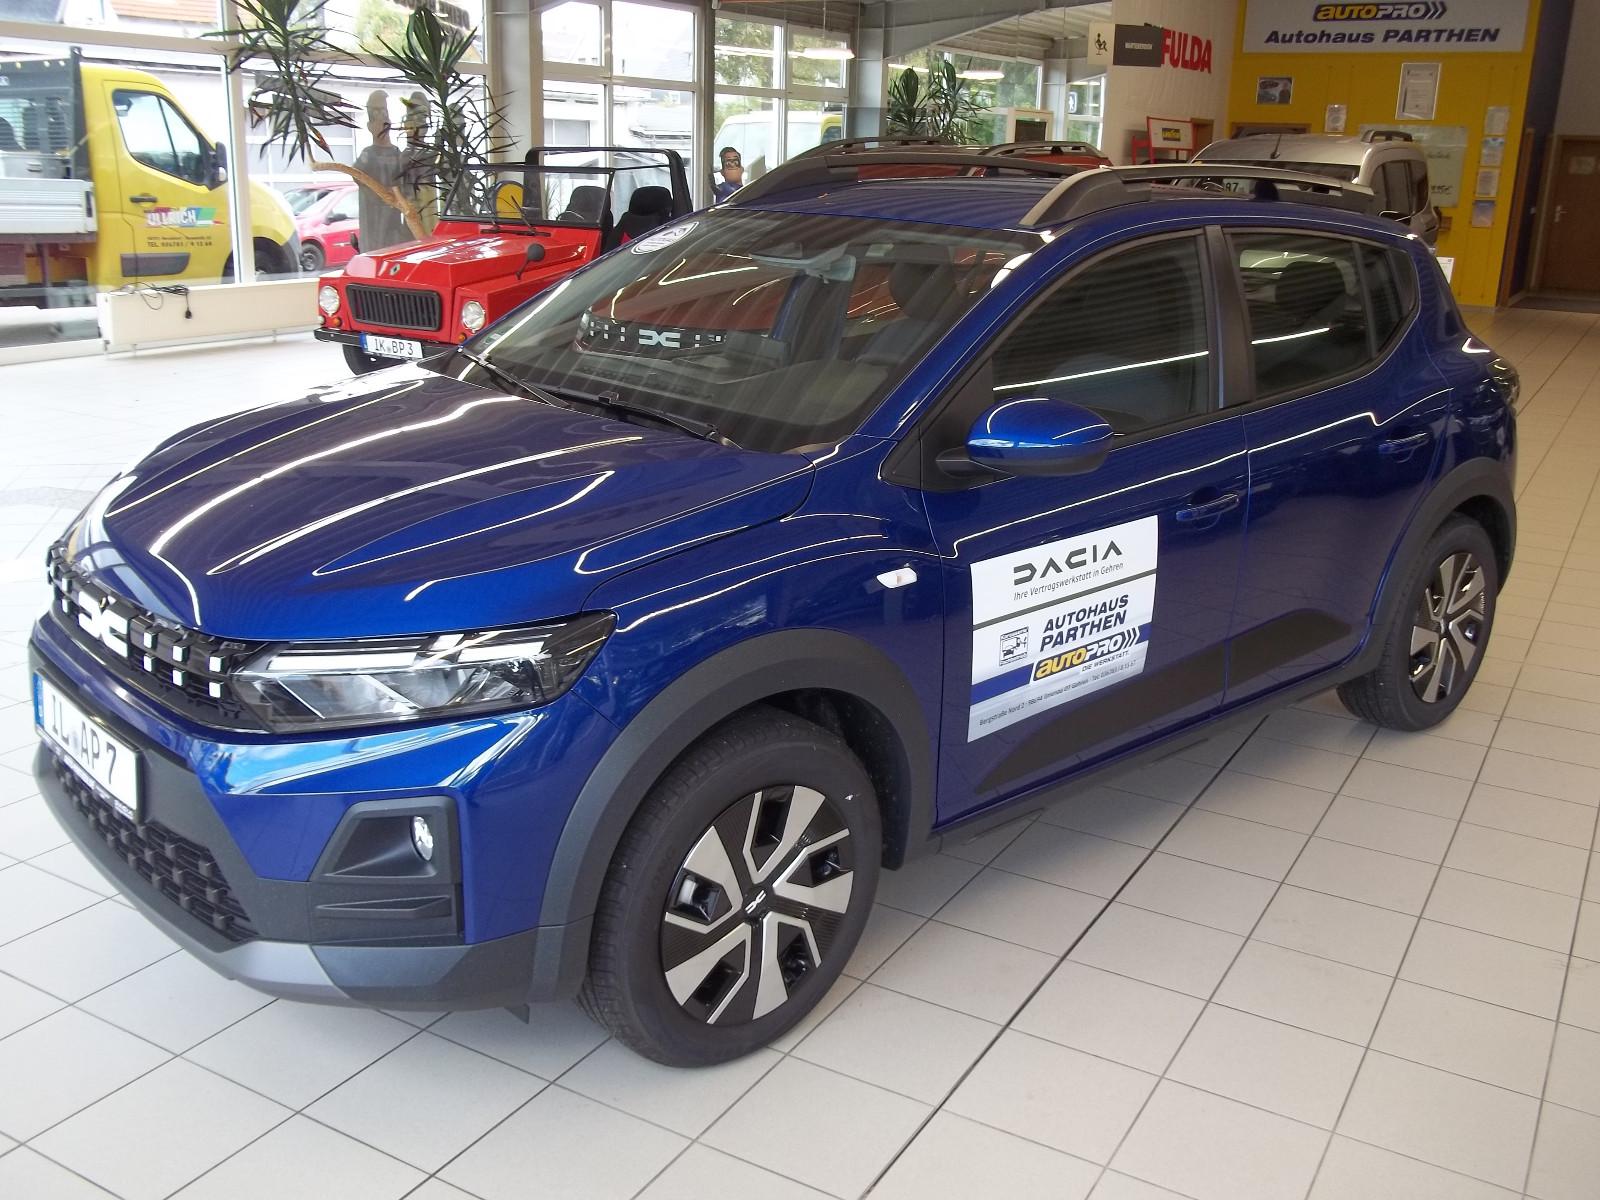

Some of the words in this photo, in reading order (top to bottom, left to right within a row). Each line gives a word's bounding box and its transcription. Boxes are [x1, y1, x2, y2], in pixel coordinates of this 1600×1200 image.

[1161, 27, 1212, 74] FULDA
[1264, 30, 1375, 44] Autohaus
[1382, 28, 1500, 43] PARTHEN
[391, 340, 405, 354] BP
[407, 342, 414, 355] 3
[1013, 540, 1122, 586] DACIA
[1013, 591, 1028, 601] Ihre
[1030, 572, 1092, 596] Vertragswerkstatt
[1092, 568, 1100, 577] in
[1100, 563, 1124, 575] Gehren
[1040, 609, 1127, 653] PARTHEN
[1043, 594, 1129, 634] AUTOHAUS
[1081, 664, 1093, 672] DIE
[52, 694, 70, 747] IL
[80, 720, 101, 770] AP
[106, 741, 117, 786] 7
